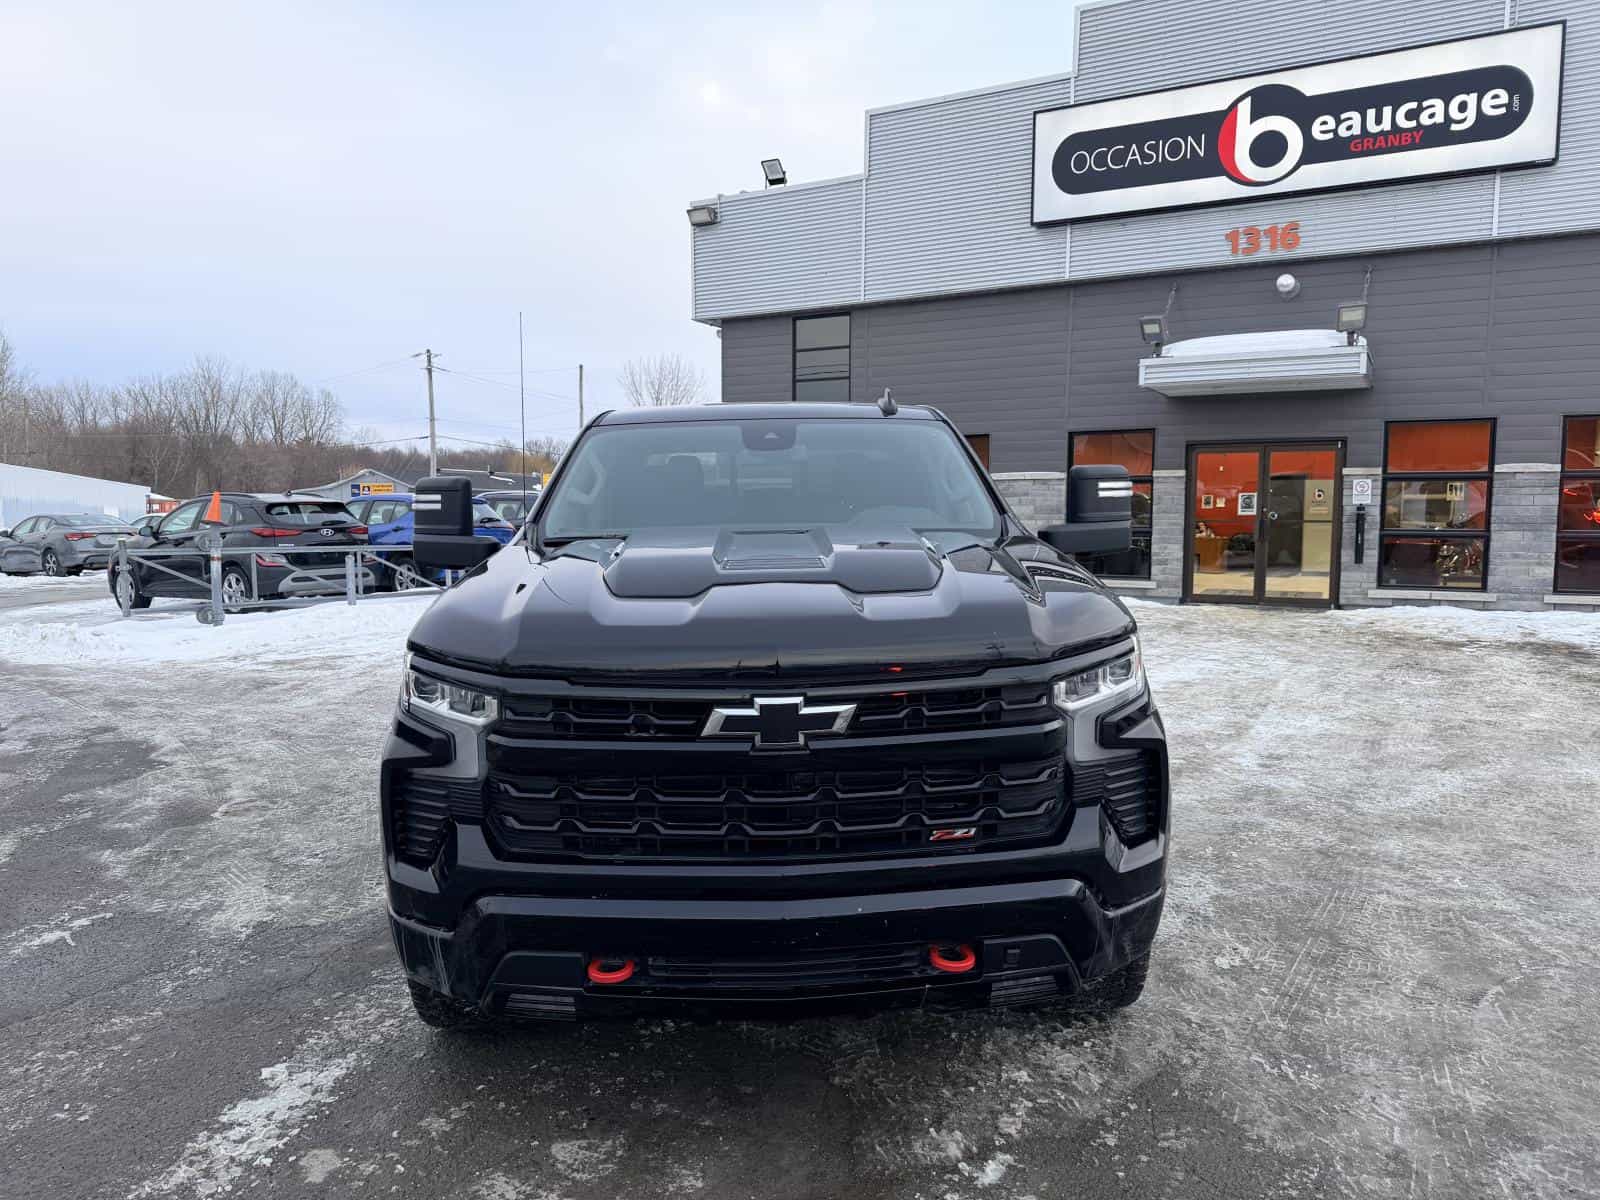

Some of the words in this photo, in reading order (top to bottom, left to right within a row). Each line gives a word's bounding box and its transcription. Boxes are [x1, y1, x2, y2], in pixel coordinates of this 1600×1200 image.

[1071, 133, 1206, 175] OCCASION
[1350, 130, 1423, 153] GRANBY
[1225, 222, 1301, 255] 1316
